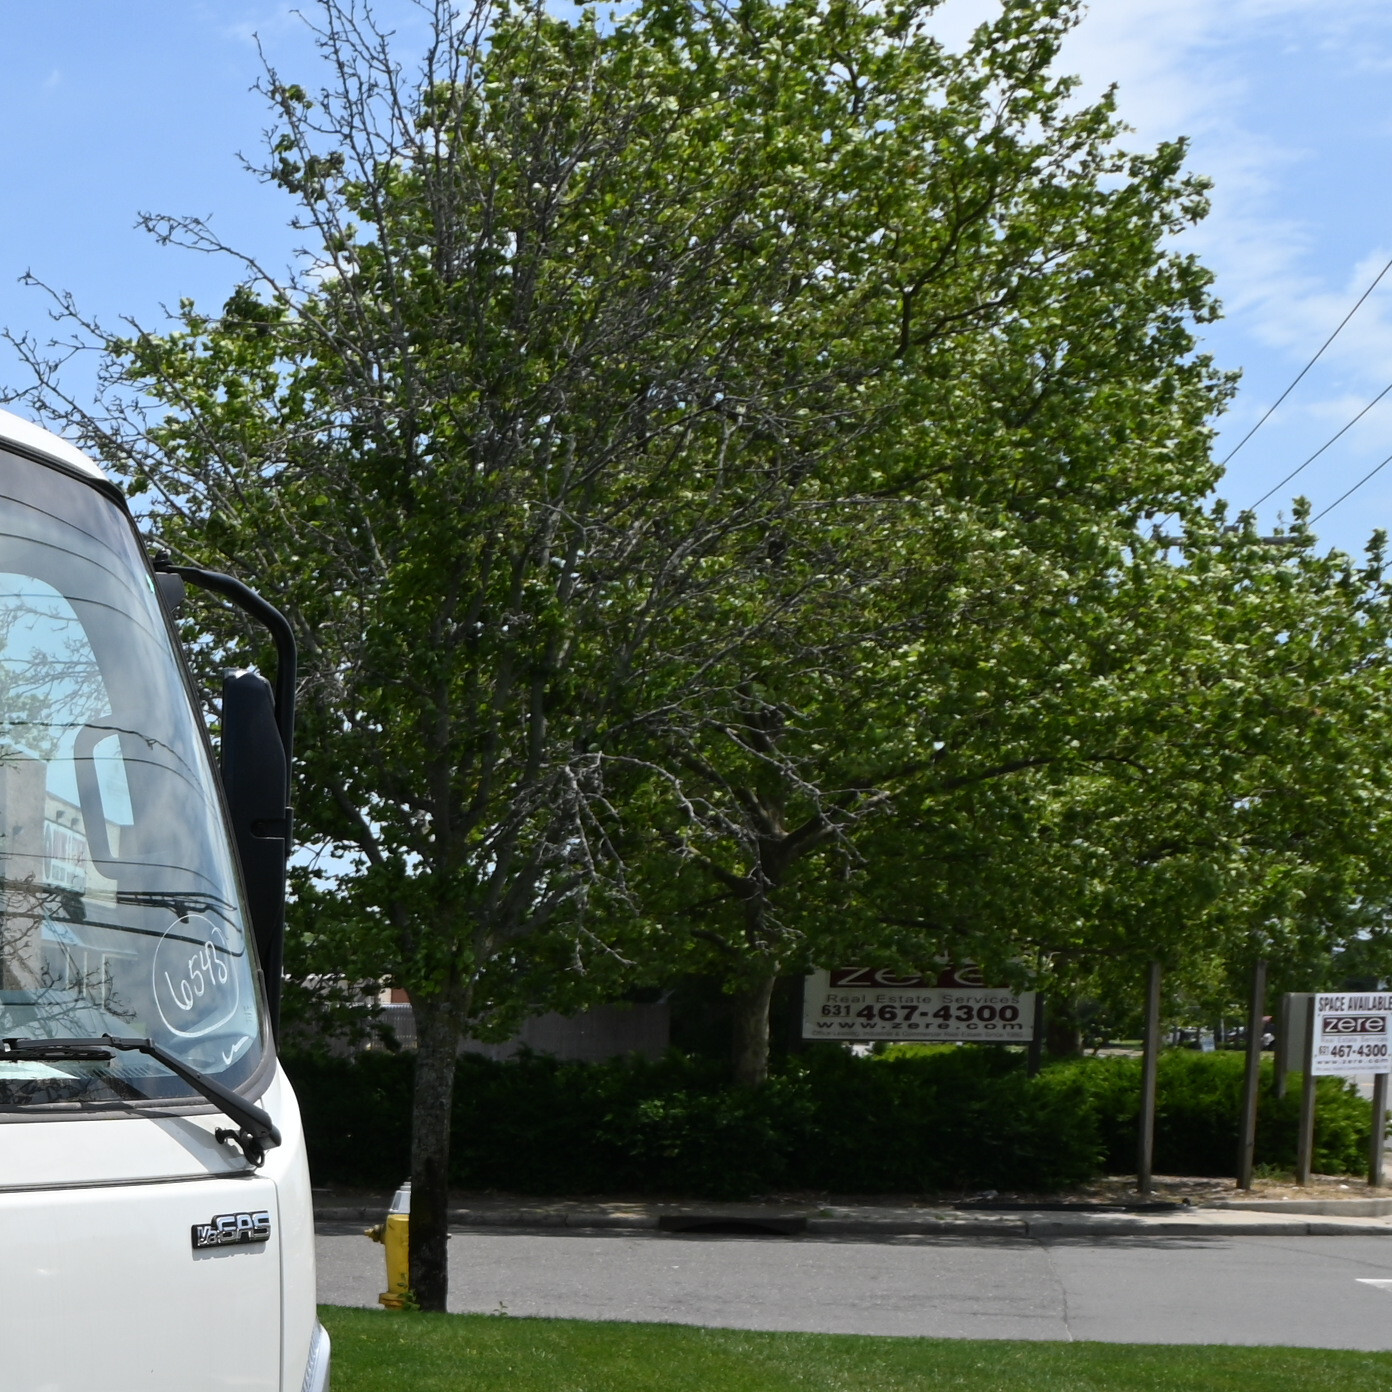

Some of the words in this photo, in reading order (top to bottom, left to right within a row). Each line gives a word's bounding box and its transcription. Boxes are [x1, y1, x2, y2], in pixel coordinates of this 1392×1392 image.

[826, 994, 866, 1004] Real
[876, 994, 932, 1004] Estate
[942, 994, 1020, 1004] Services
[1318, 996, 1346, 1012] SPACE
[822, 1004, 851, 1017] 631
[856, 1004, 1020, 1022] 467-4300
[817, 1020, 1023, 1030] www.zere.com
[1325, 1017, 1384, 1032] zere
[1330, 1044, 1388, 1057] 467-4300
[217, 1212, 271, 1242] GAS
